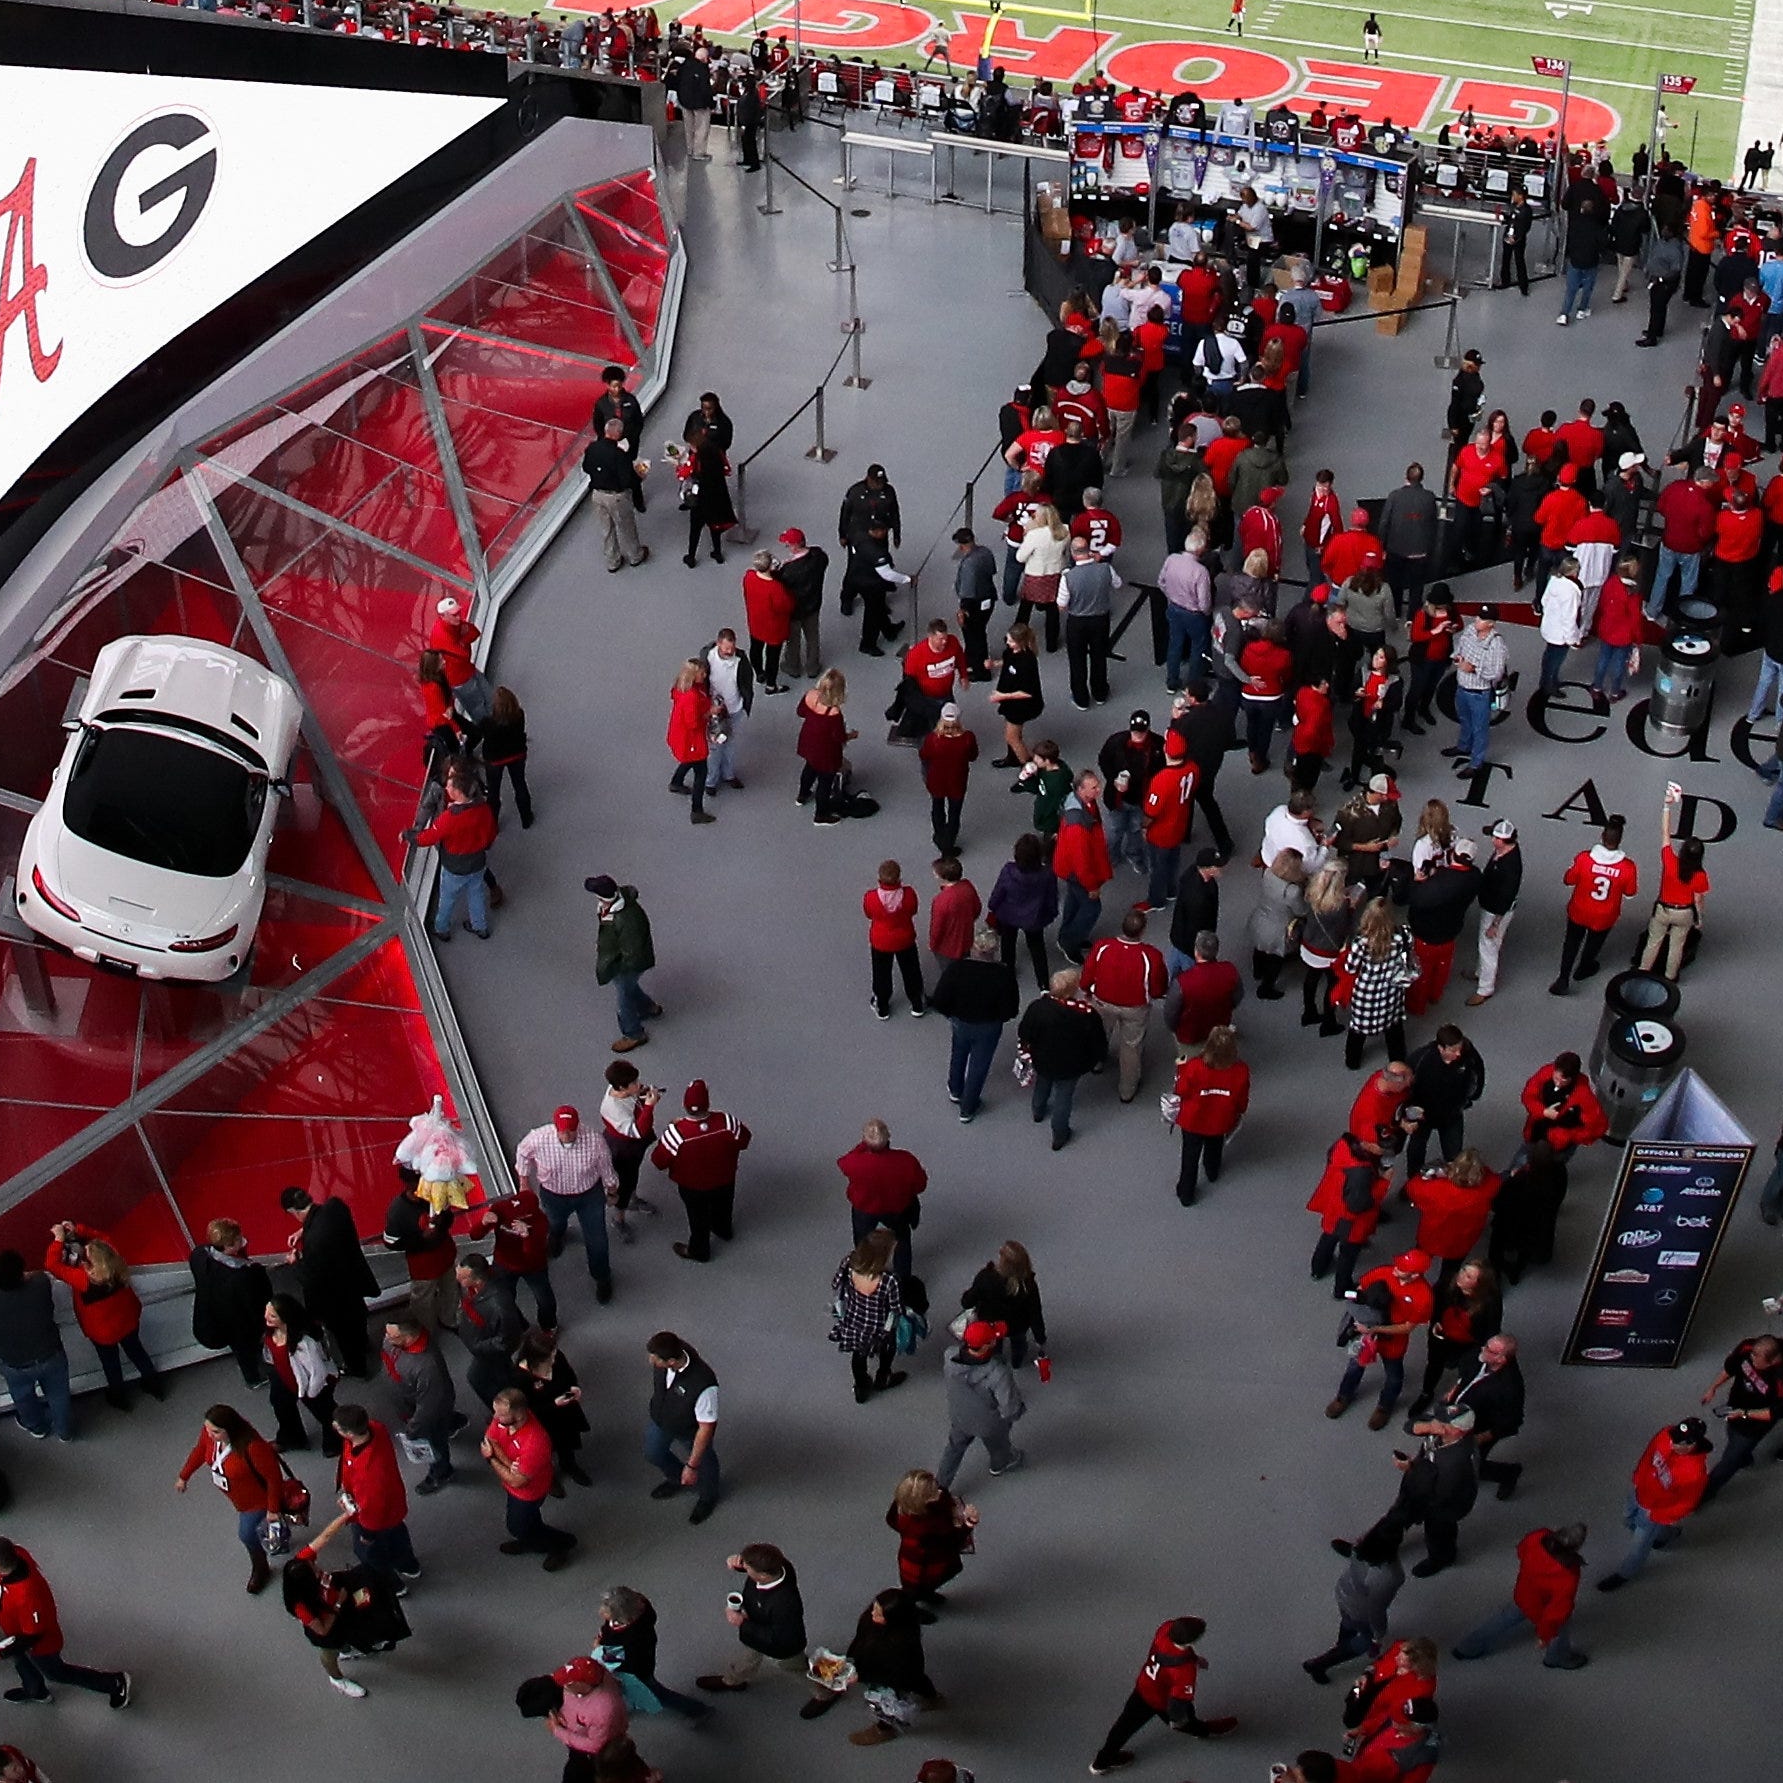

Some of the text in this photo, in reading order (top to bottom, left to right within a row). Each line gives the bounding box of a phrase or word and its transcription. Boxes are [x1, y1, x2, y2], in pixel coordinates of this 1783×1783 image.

[1546, 58, 1564, 71] 136
[1662, 75, 1682, 87] 135
[82, 112, 217, 280] G
[1089, 528, 1107, 552] 2
[1179, 771, 1194, 805] 11
[1590, 876, 1611, 902] 3
[1636, 1148, 1746, 1160] OFFICIAL SPONSORS
[1648, 1164, 1692, 1175] Academy
[1679, 1186, 1722, 1197] Allstate
[1633, 1203, 1665, 1214] AT&T
[1675, 1214, 1713, 1229] belk
